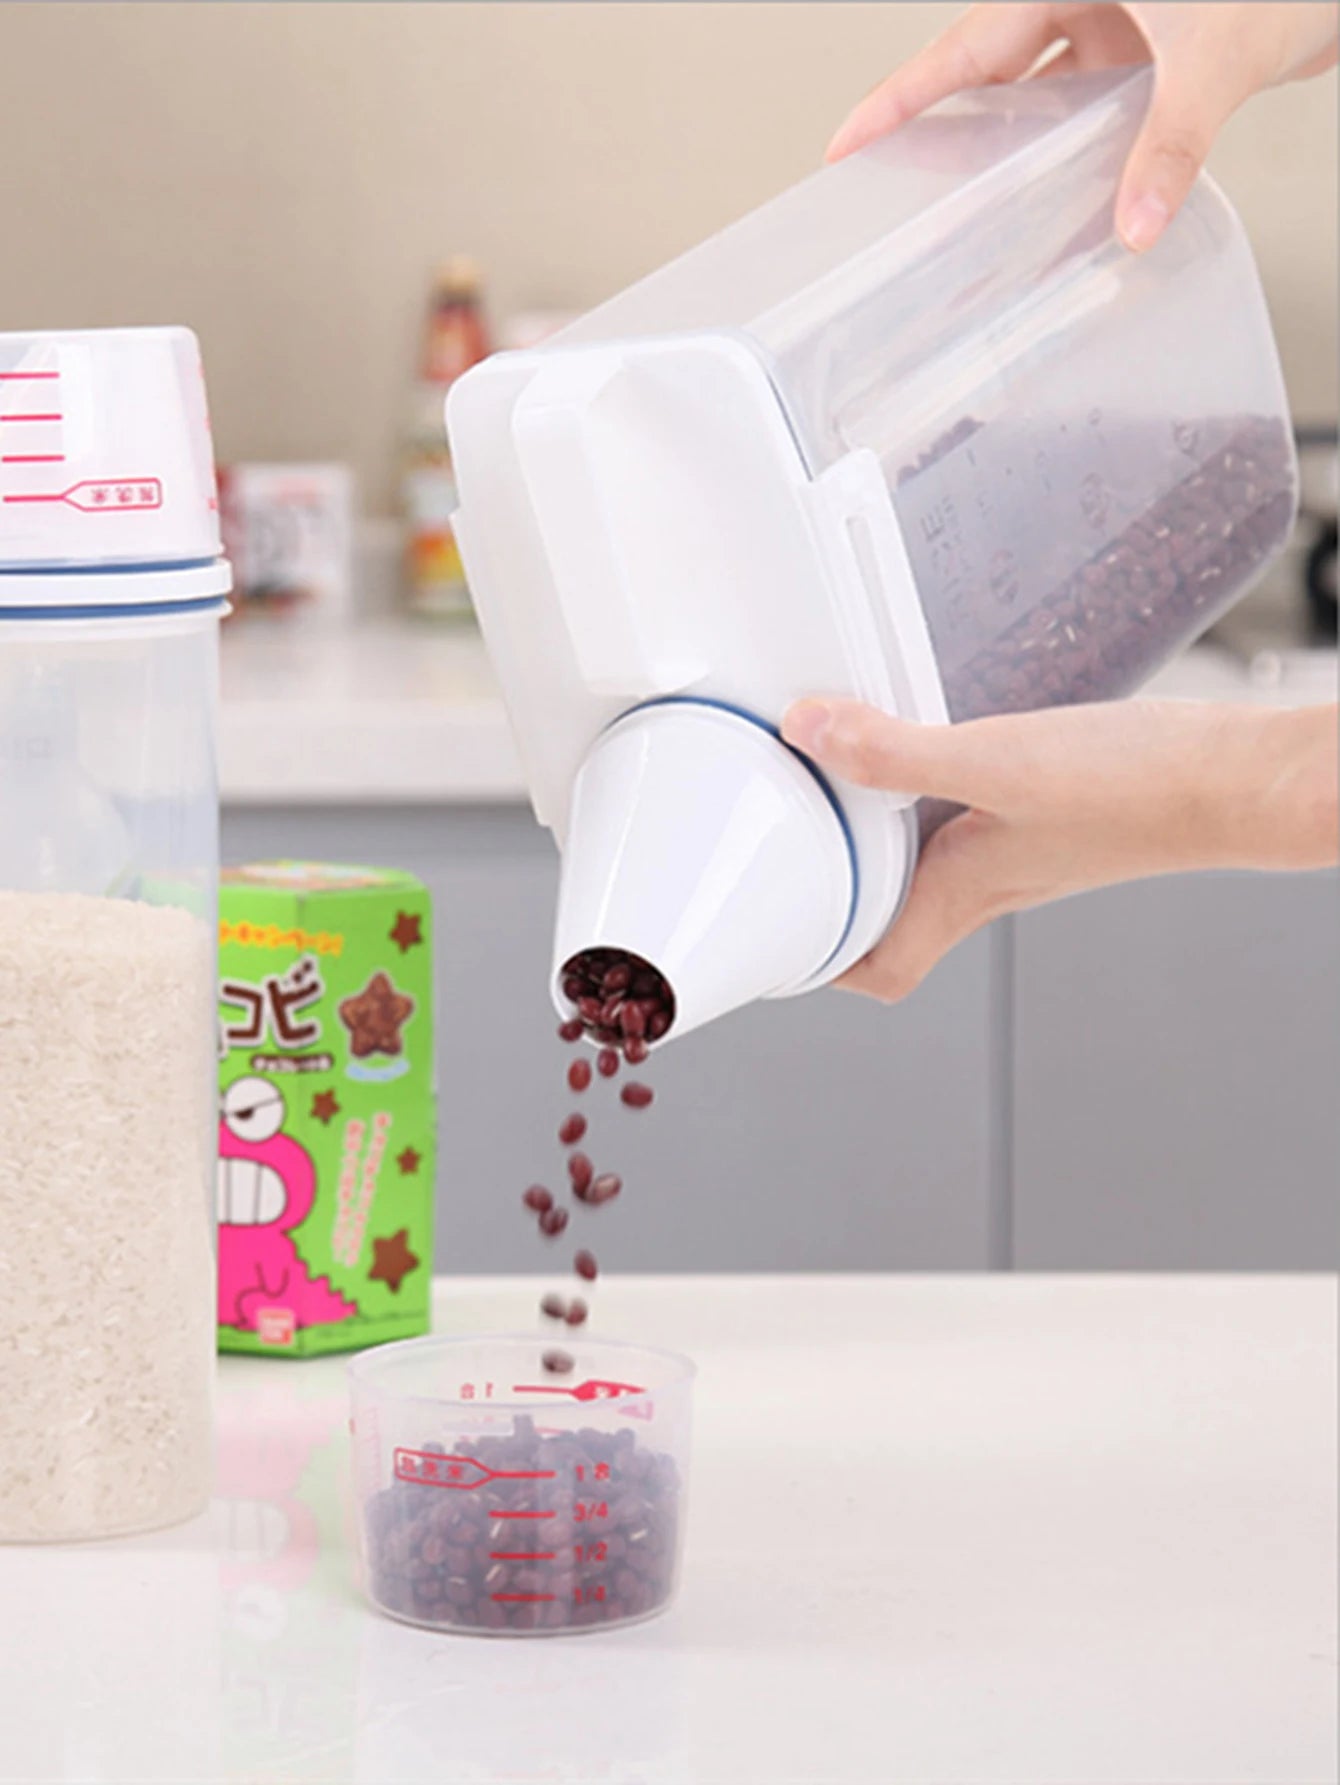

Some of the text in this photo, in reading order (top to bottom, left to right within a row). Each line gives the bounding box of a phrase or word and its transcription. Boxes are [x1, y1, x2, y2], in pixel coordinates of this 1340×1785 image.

[219, 957, 322, 1045] コビ
[573, 1501, 608, 1522] 3/4
[573, 1541, 608, 1562] 1/2
[573, 1585, 606, 1605] 1/4
